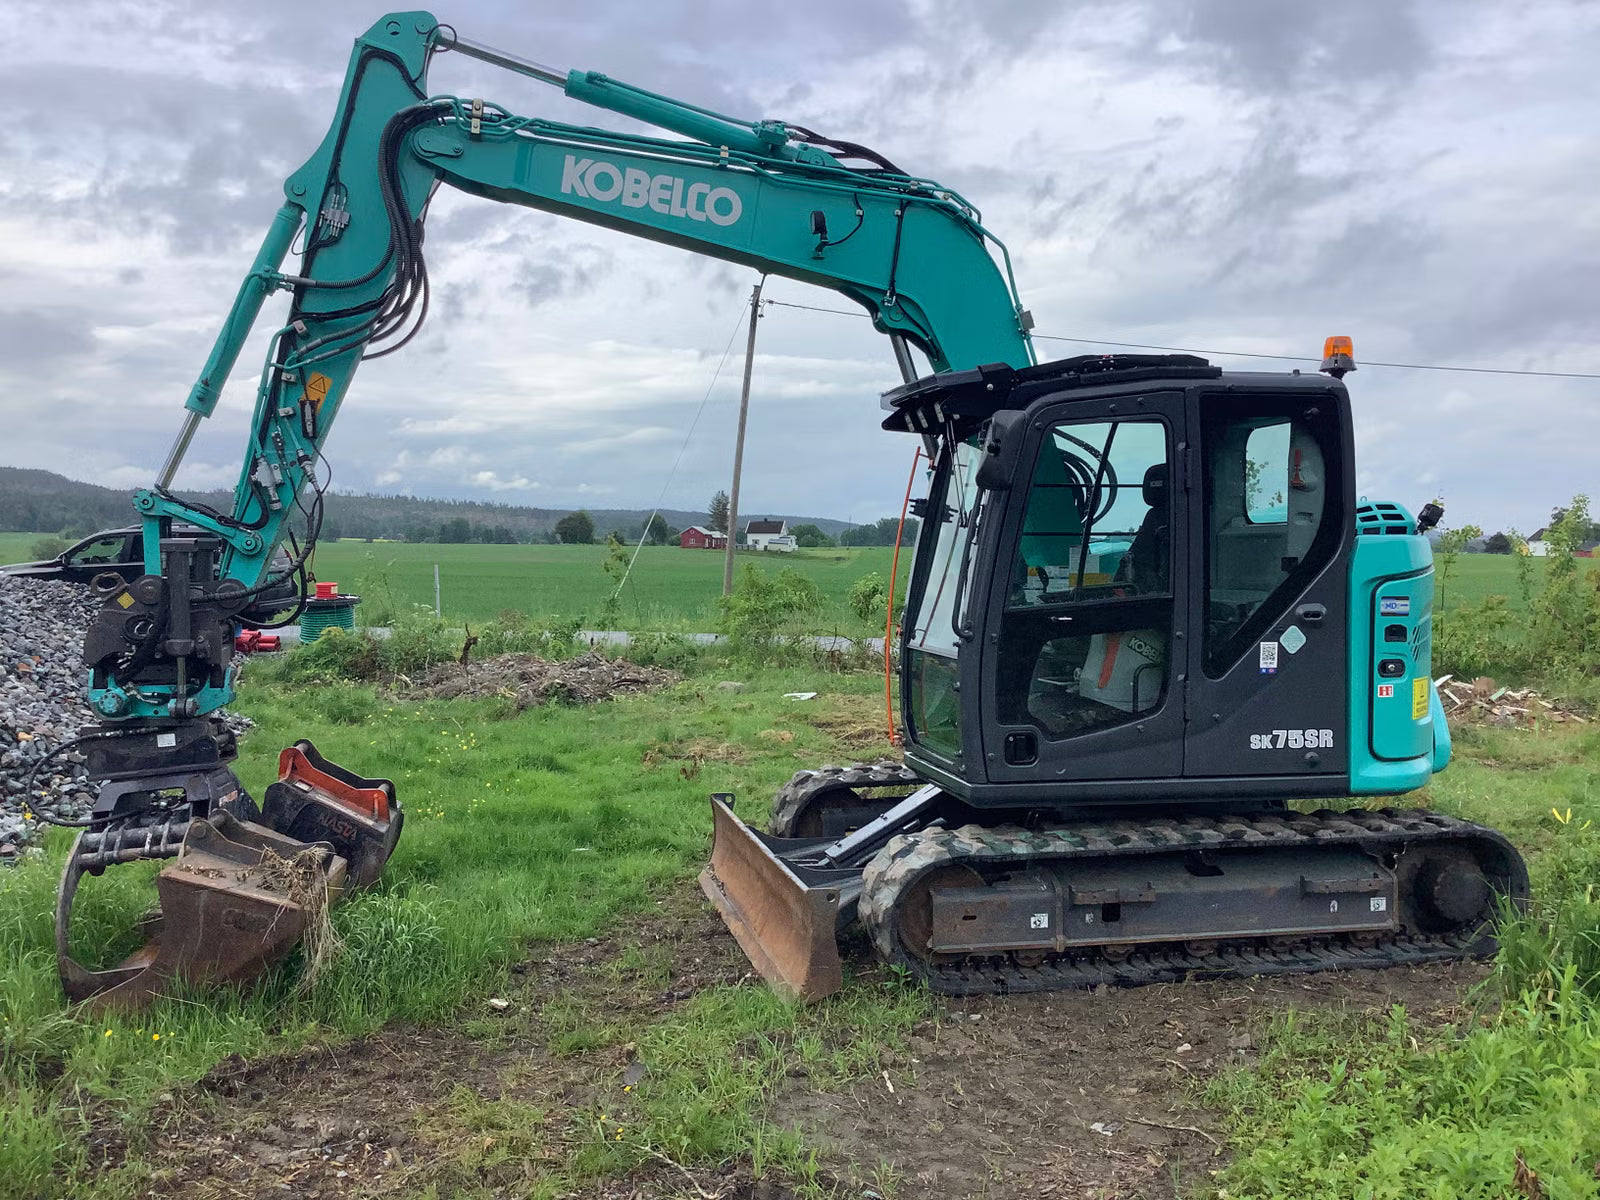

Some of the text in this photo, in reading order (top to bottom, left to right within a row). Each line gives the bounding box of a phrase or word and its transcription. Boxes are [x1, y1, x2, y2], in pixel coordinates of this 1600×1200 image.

[561, 154, 743, 226] KOBELCO
[1128, 637, 1158, 661] KOBE
[1250, 729, 1334, 749] SK75SR
